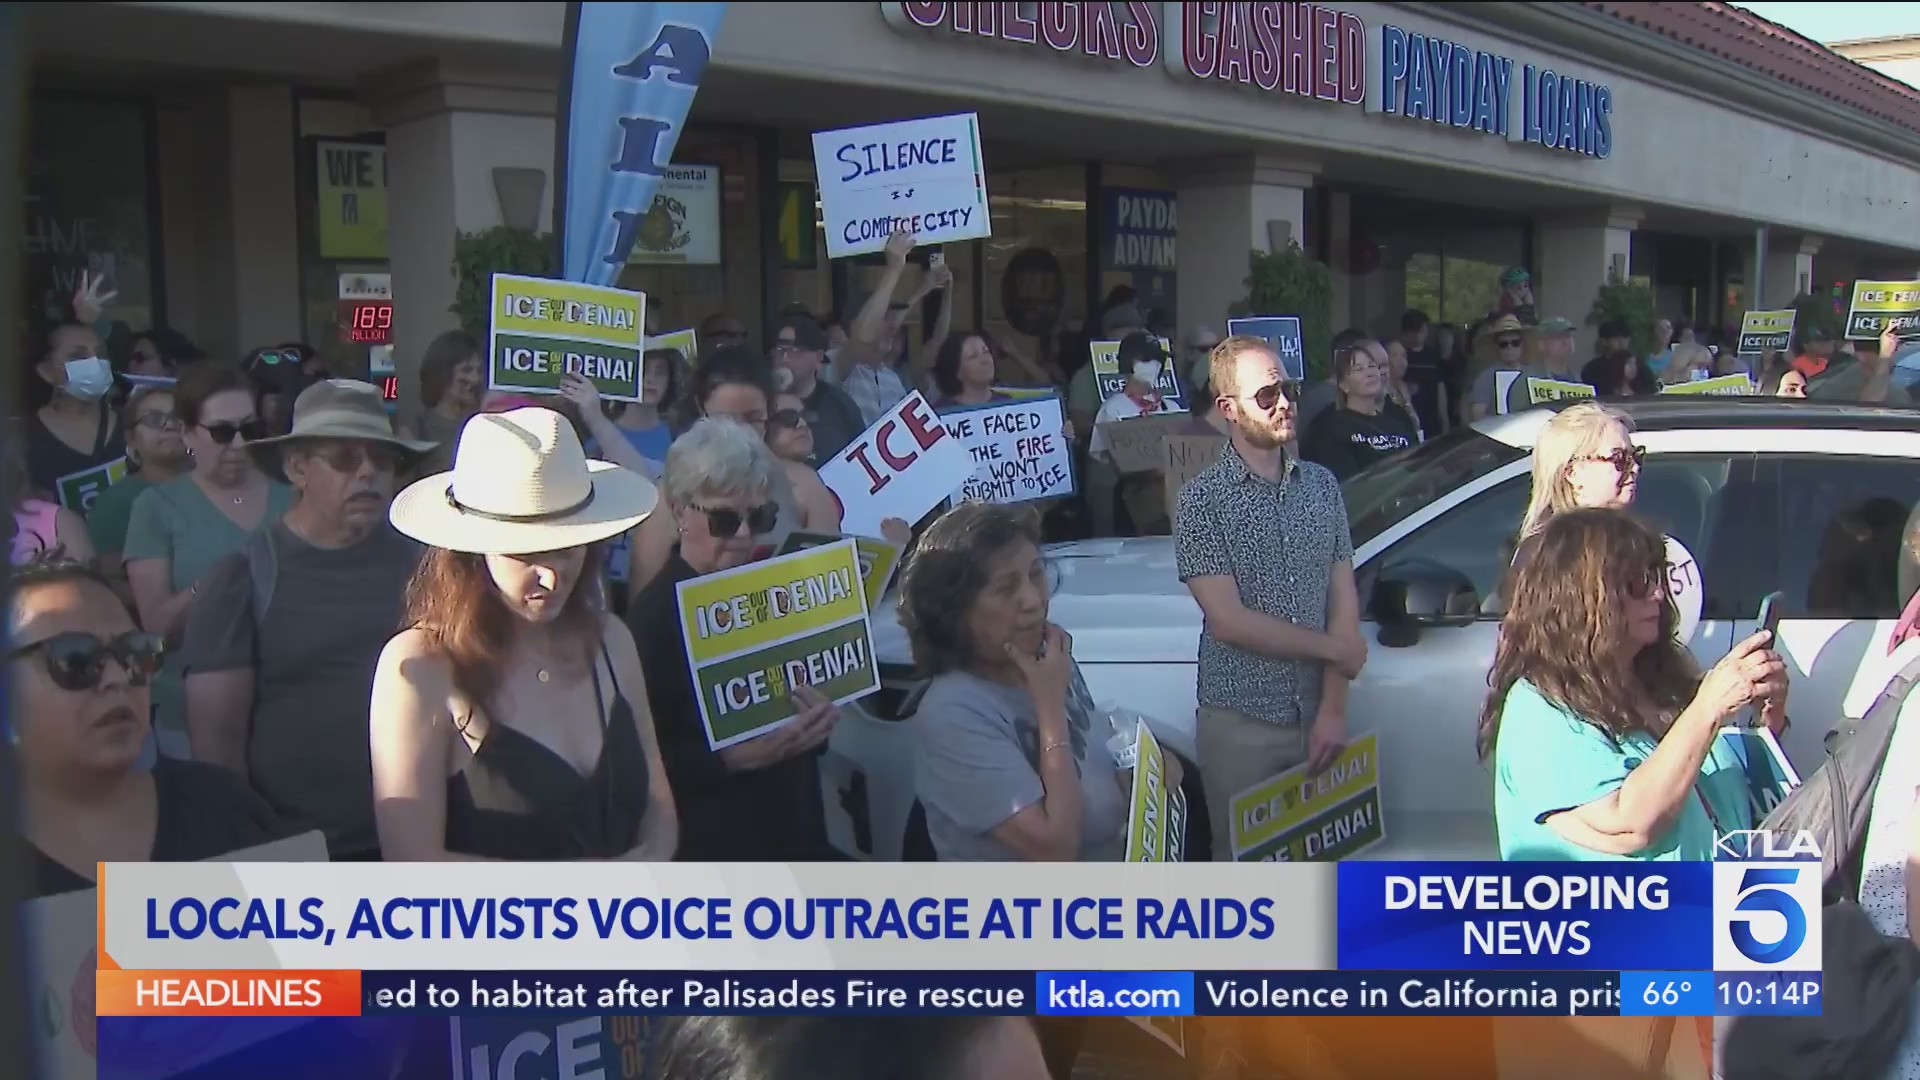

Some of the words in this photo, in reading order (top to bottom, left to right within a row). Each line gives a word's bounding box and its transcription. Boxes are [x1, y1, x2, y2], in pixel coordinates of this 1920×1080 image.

[905, 2, 1158, 67] CKS
[1183, 2, 1367, 104] CASHED
[1382, 24, 1515, 135] PAYDAY
[1523, 64, 1613, 159] LOANS
[325, 149, 374, 188] WE
[836, 138, 957, 182] SILENCE
[891, 188, 915, 200] IS
[504, 294, 550, 320] ICE
[565, 299, 635, 331] DENA!
[1860, 291, 1885, 302] ICE
[353, 306, 392, 328] 189
[1855, 317, 1880, 330] ICE
[504, 347, 549, 373] ICE
[565, 353, 633, 382] DENA!
[947, 418, 974, 440] WE
[983, 413, 1042, 436] FACED
[845, 397, 947, 496] ICE
[969, 443, 1002, 463] THE
[1016, 434, 1055, 459] FIRE
[963, 477, 1016, 501] SUBMIT
[1022, 478, 1036, 490] TO
[1035, 464, 1067, 494] ICE
[989, 457, 1040, 480] WON'T
[696, 595, 753, 638] ICE
[767, 567, 852, 618] DENA!
[713, 670, 771, 716] ICE
[785, 637, 865, 693] DENA!
[1301, 751, 1369, 803] DENA!
[1141, 754, 1161, 862] ENA!
[1305, 802, 1374, 858] DENA!
